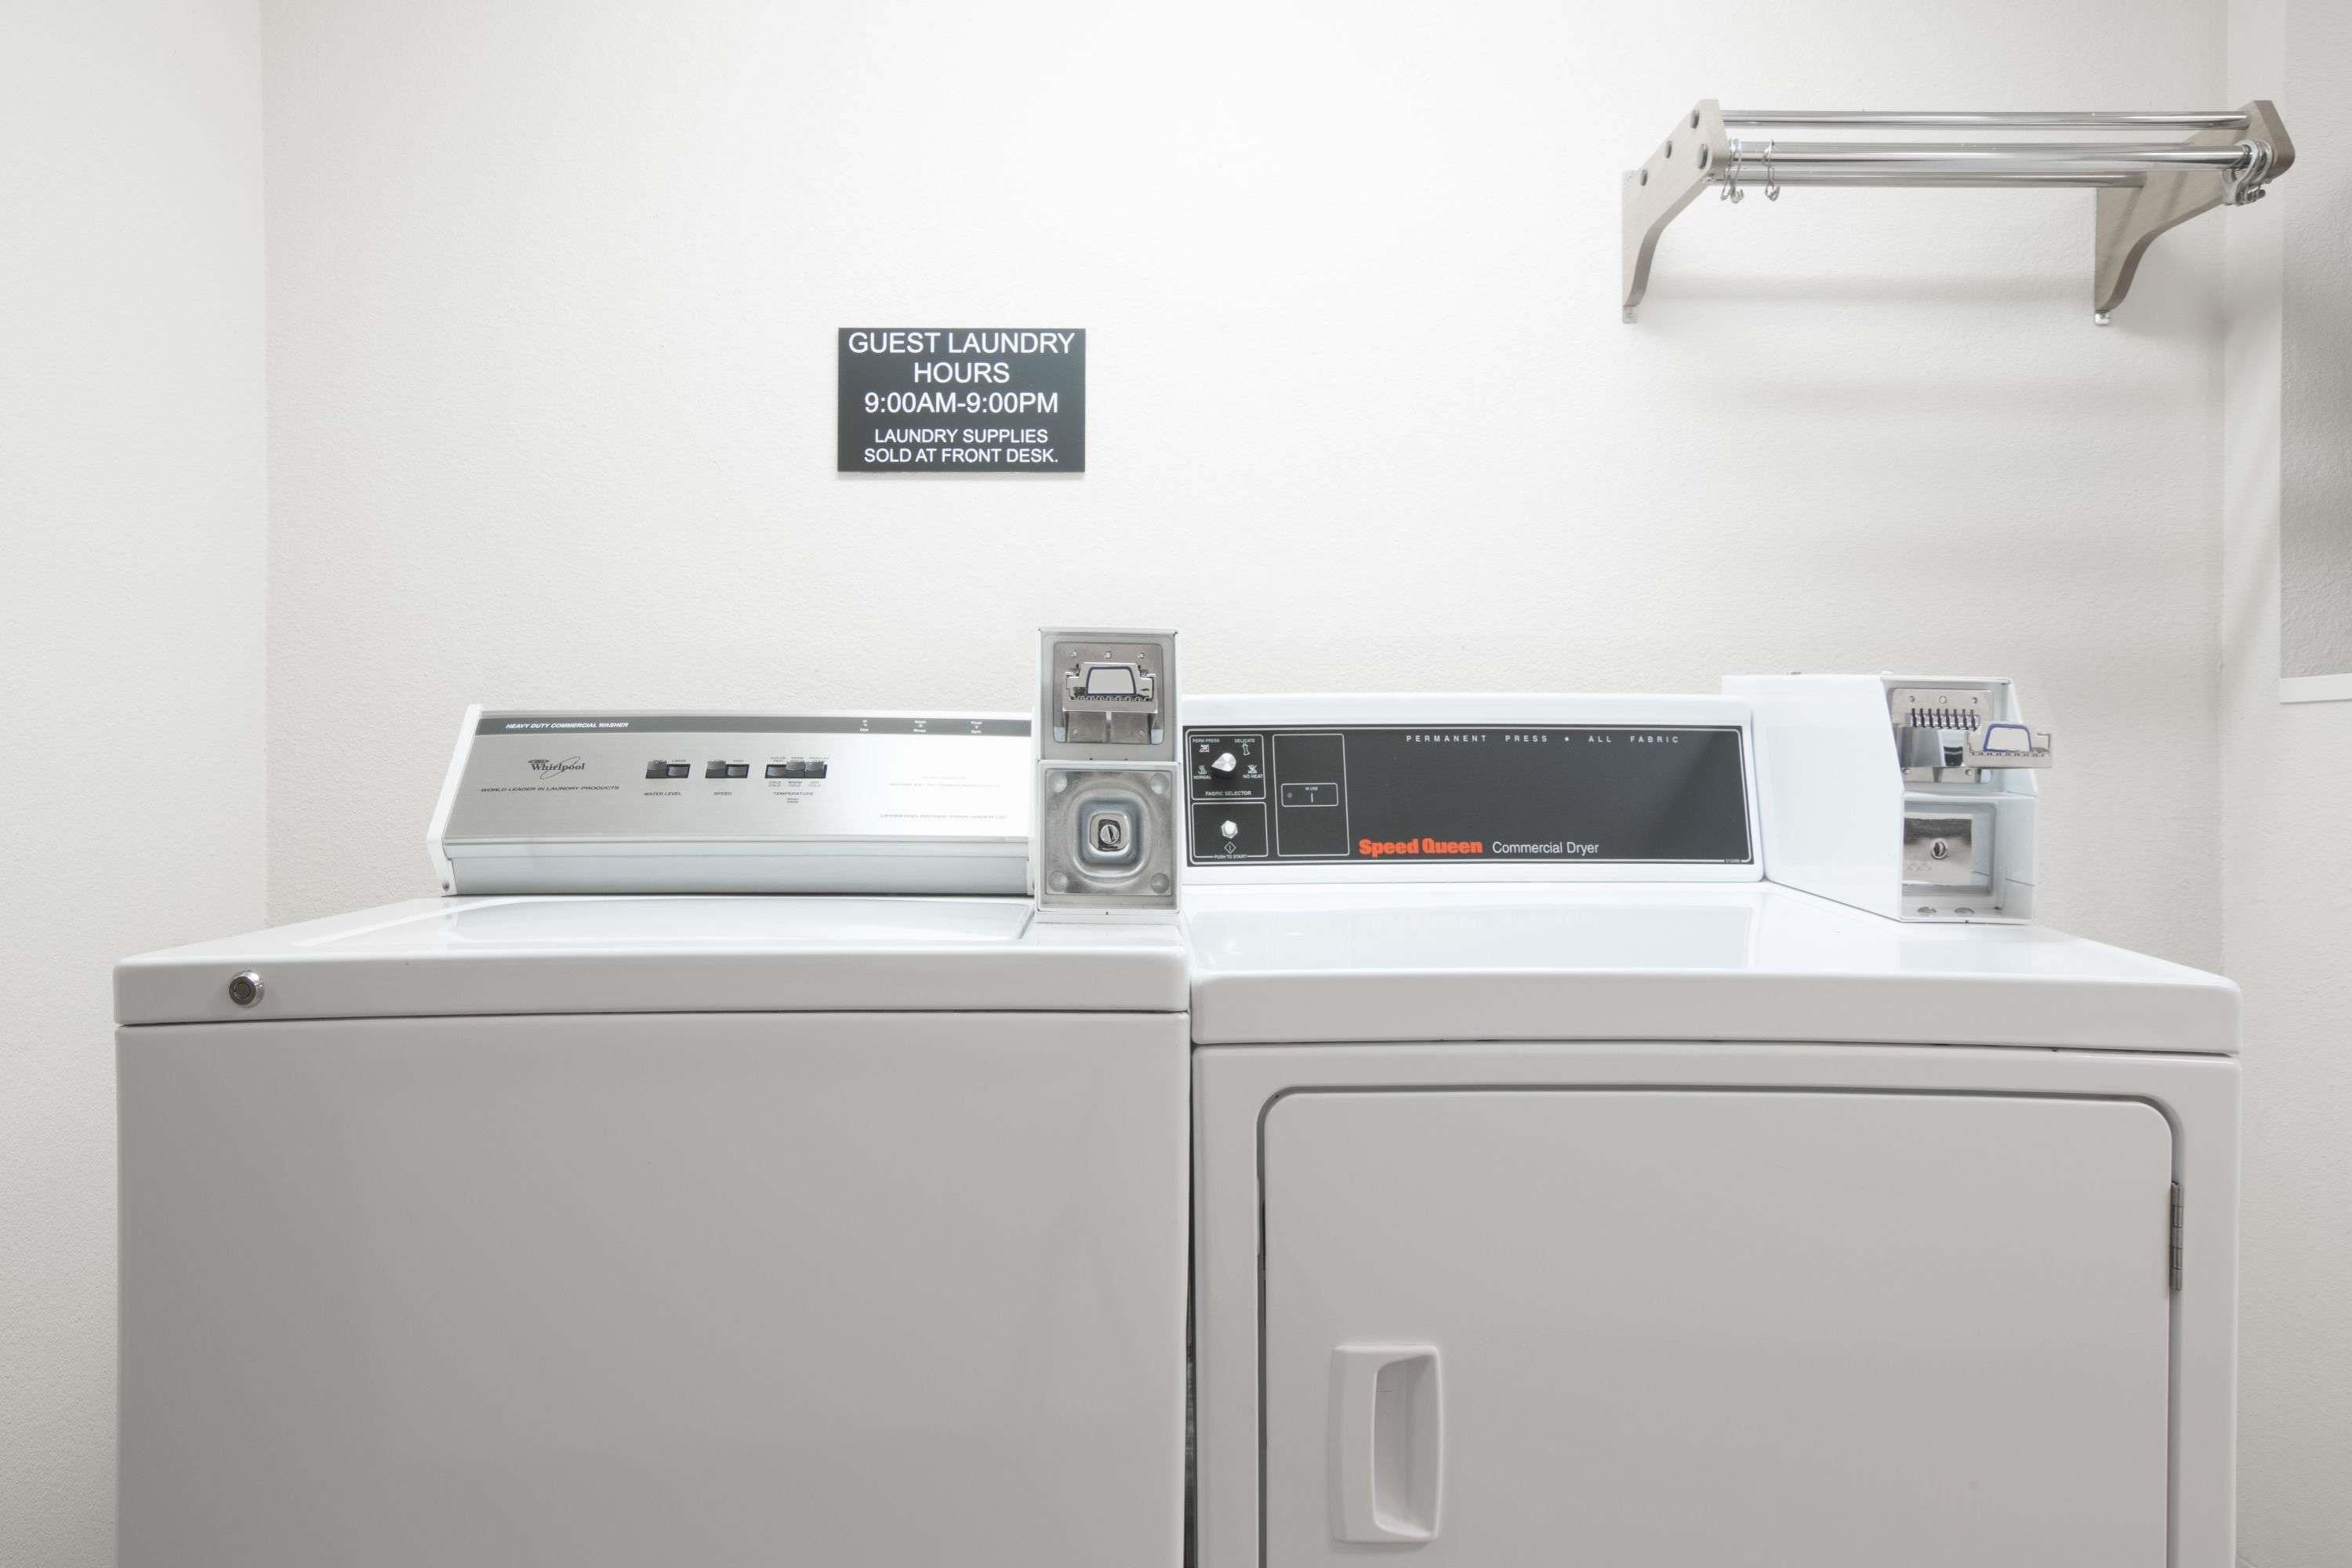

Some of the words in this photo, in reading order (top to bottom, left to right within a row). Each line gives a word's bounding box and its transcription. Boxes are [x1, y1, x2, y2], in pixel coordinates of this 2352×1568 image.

[848, 332, 941, 354] GUEST
[948, 332, 1076, 354] LAUNDRY
[913, 361, 1011, 383] HOURS
[864, 391, 1058, 413] 9:00AM-9:00PM
[874, 428, 959, 444] LAUNDRY
[962, 428, 1049, 444] SUPPLIES
[863, 448, 912, 463] SOLD
[915, 448, 937, 463] AT
[941, 448, 1002, 463] FRONT
[1006, 448, 1058, 463] DESK.
[1406, 734, 1486, 742] PERMANENT
[1588, 735, 1613, 743] ALL
[1630, 735, 1679, 744] FABRIC
[529, 762, 586, 773] Whirlpool
[1358, 837, 1419, 858] Speed
[1421, 837, 1483, 855] Queen
[1492, 840, 1563, 855] Commercial
[1566, 841, 1599, 856] Dryer
